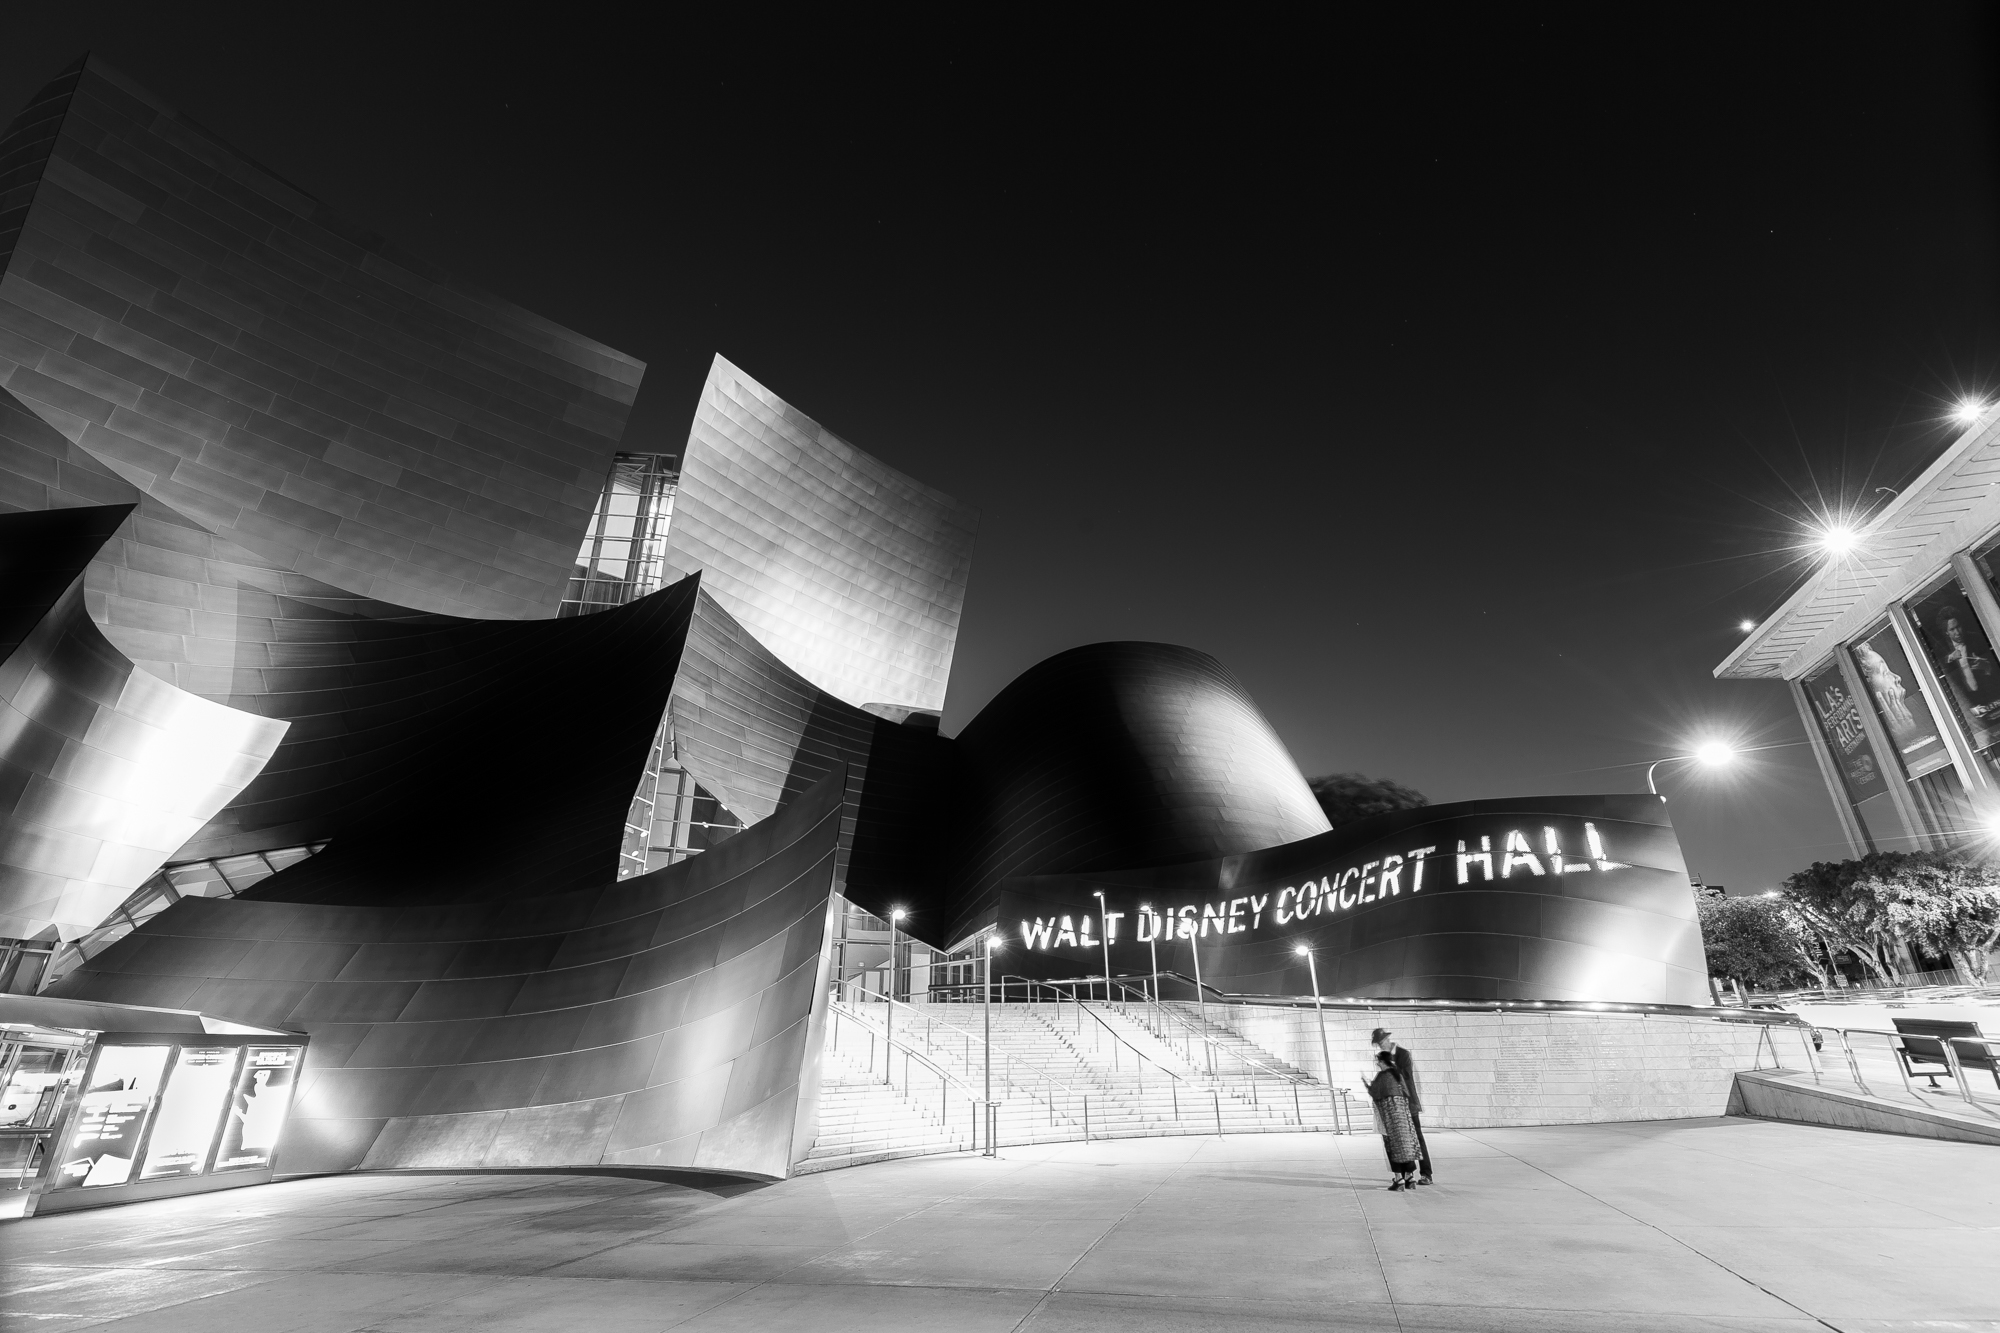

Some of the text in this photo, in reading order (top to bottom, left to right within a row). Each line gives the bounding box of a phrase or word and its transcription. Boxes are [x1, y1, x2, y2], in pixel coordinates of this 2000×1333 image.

[1824, 695, 1855, 732] PERFORMING
[1836, 708, 1864, 748] ARTS
[1021, 822, 1630, 950] WALT DISNEY CONCERT HALL
